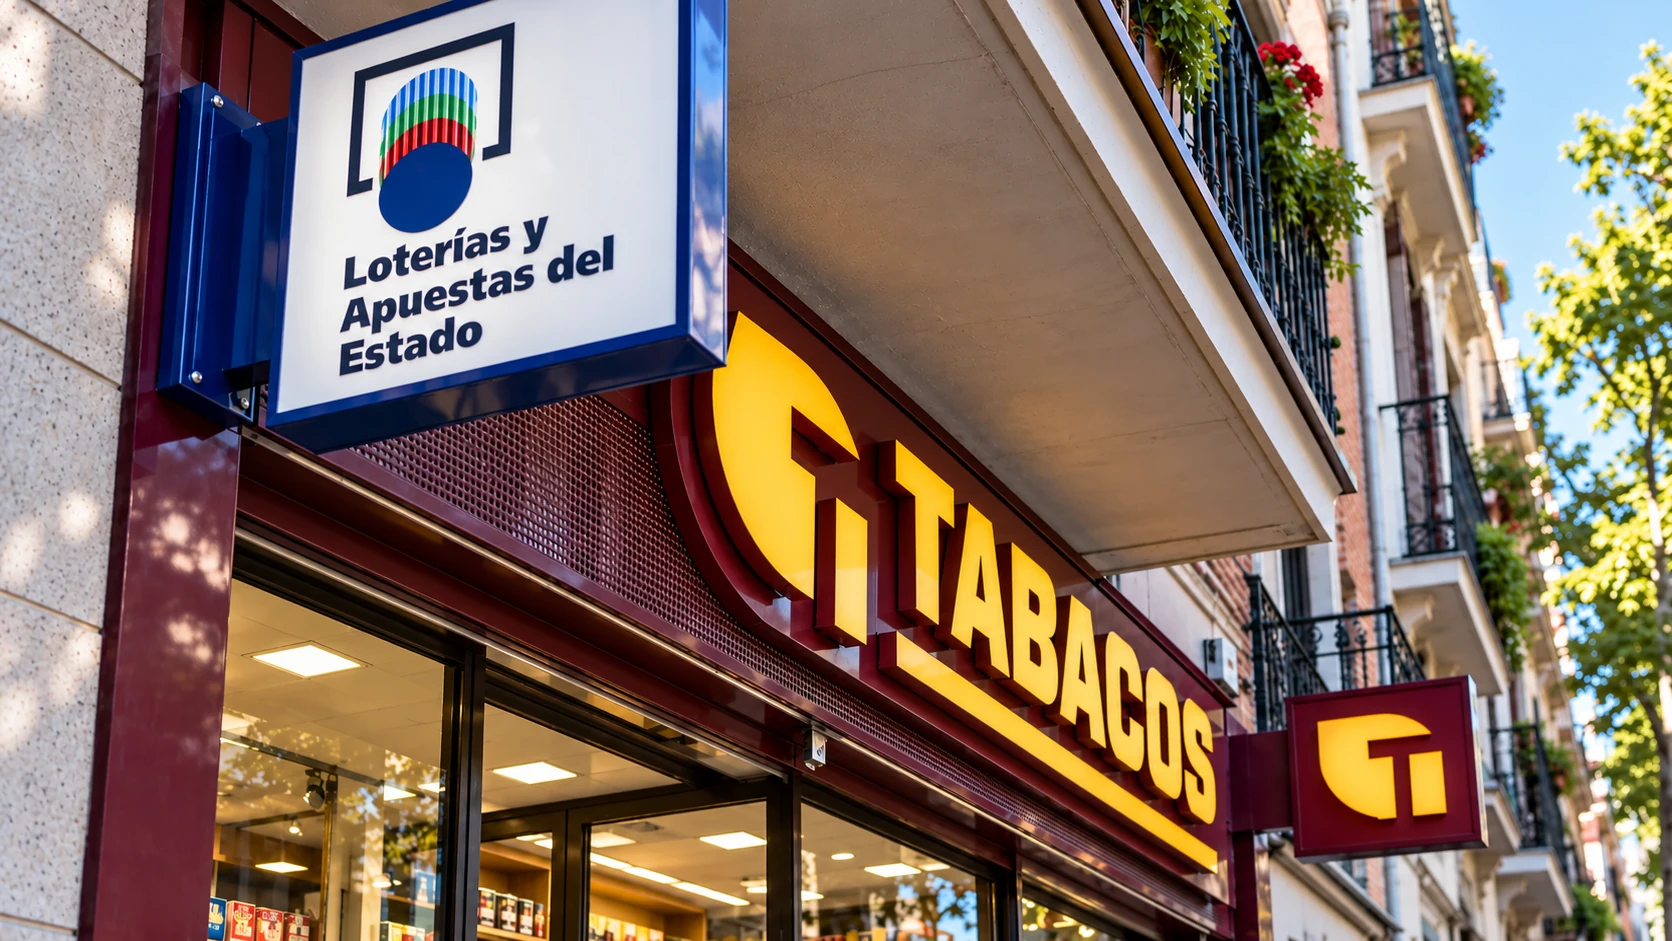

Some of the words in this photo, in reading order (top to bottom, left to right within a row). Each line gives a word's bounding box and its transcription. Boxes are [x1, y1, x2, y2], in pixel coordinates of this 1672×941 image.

[339, 264, 535, 335] Apuestas
[547, 234, 615, 284] del
[343, 225, 511, 291] Loterías
[523, 215, 550, 255] y
[339, 316, 483, 377] Estado
[894, 439, 1217, 824] TABACOS
